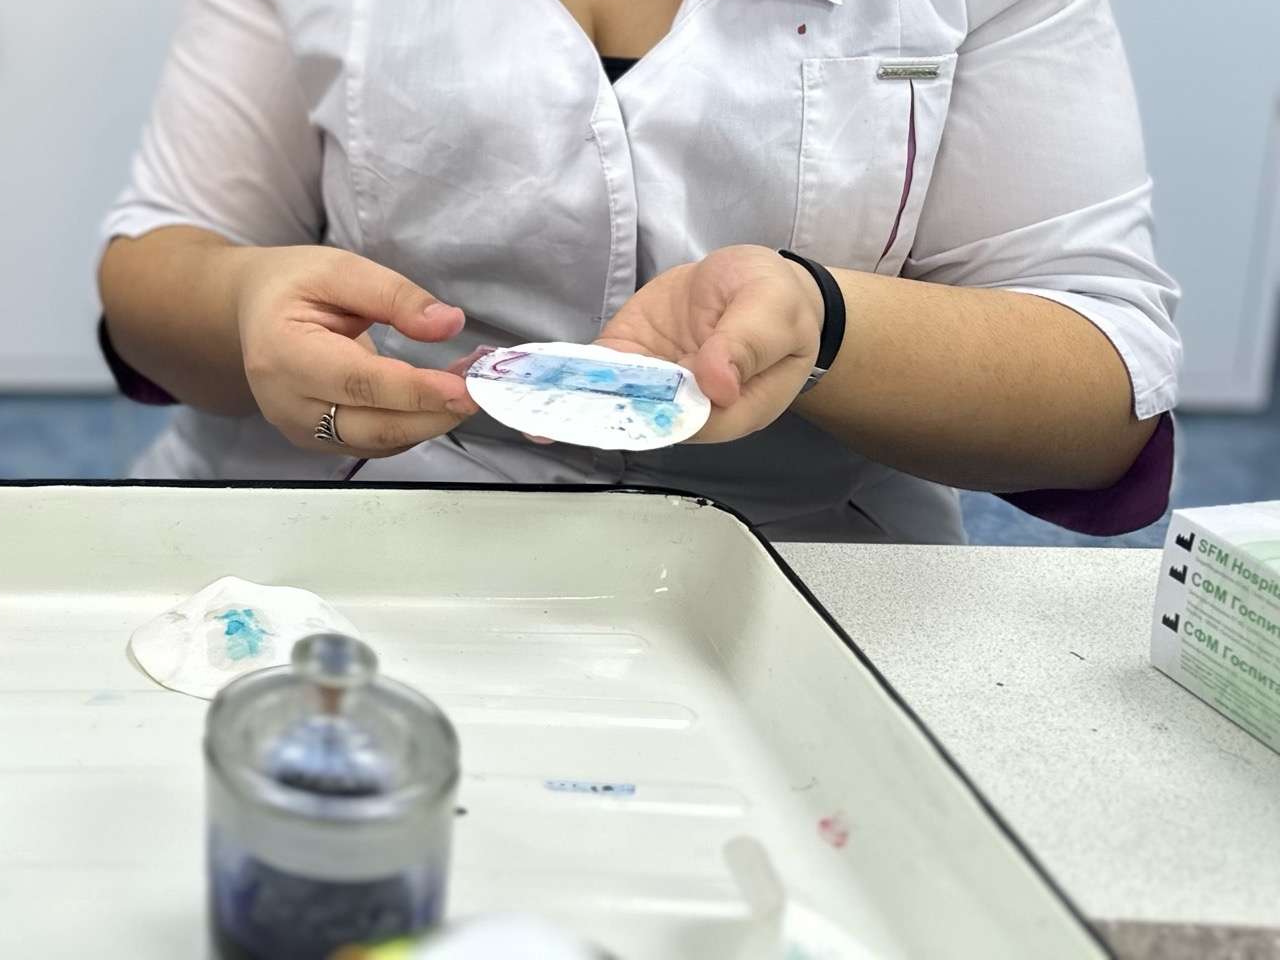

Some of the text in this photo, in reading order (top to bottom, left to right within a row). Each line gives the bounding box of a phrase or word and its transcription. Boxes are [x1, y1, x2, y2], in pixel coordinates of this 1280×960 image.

[1198, 539, 1229, 567] SFM
[1231, 558, 1280, 600] Hospit
[1191, 572, 1228, 603] СФМ
[1183, 621, 1220, 653] СФМ
